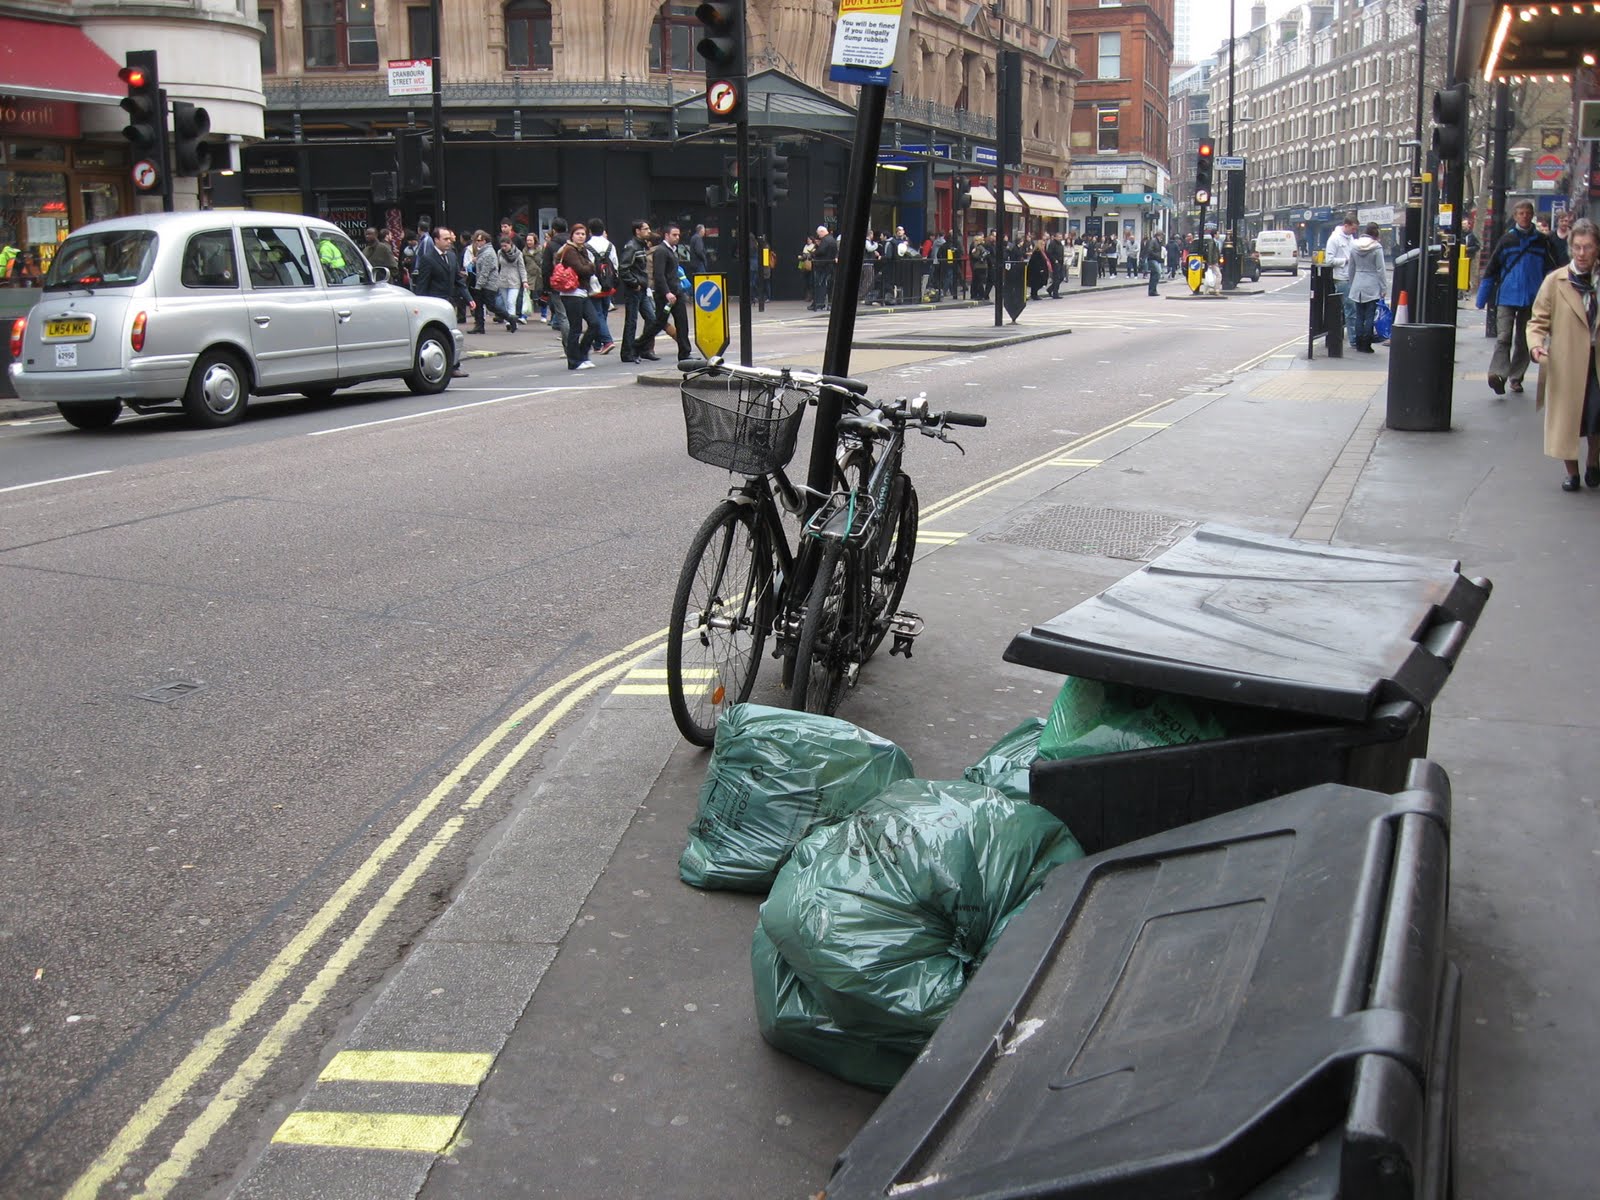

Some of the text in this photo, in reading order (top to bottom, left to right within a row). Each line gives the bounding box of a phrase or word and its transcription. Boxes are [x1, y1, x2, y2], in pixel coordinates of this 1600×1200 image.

[865, 28, 890, 37] illegally
[844, 34, 862, 42] dump
[392, 70, 425, 78] CRANBOURN
[1066, 195, 1114, 204] eurocnge
[335, 220, 368, 229] ENING
[49, 322, 89, 335] LM54 MKC
